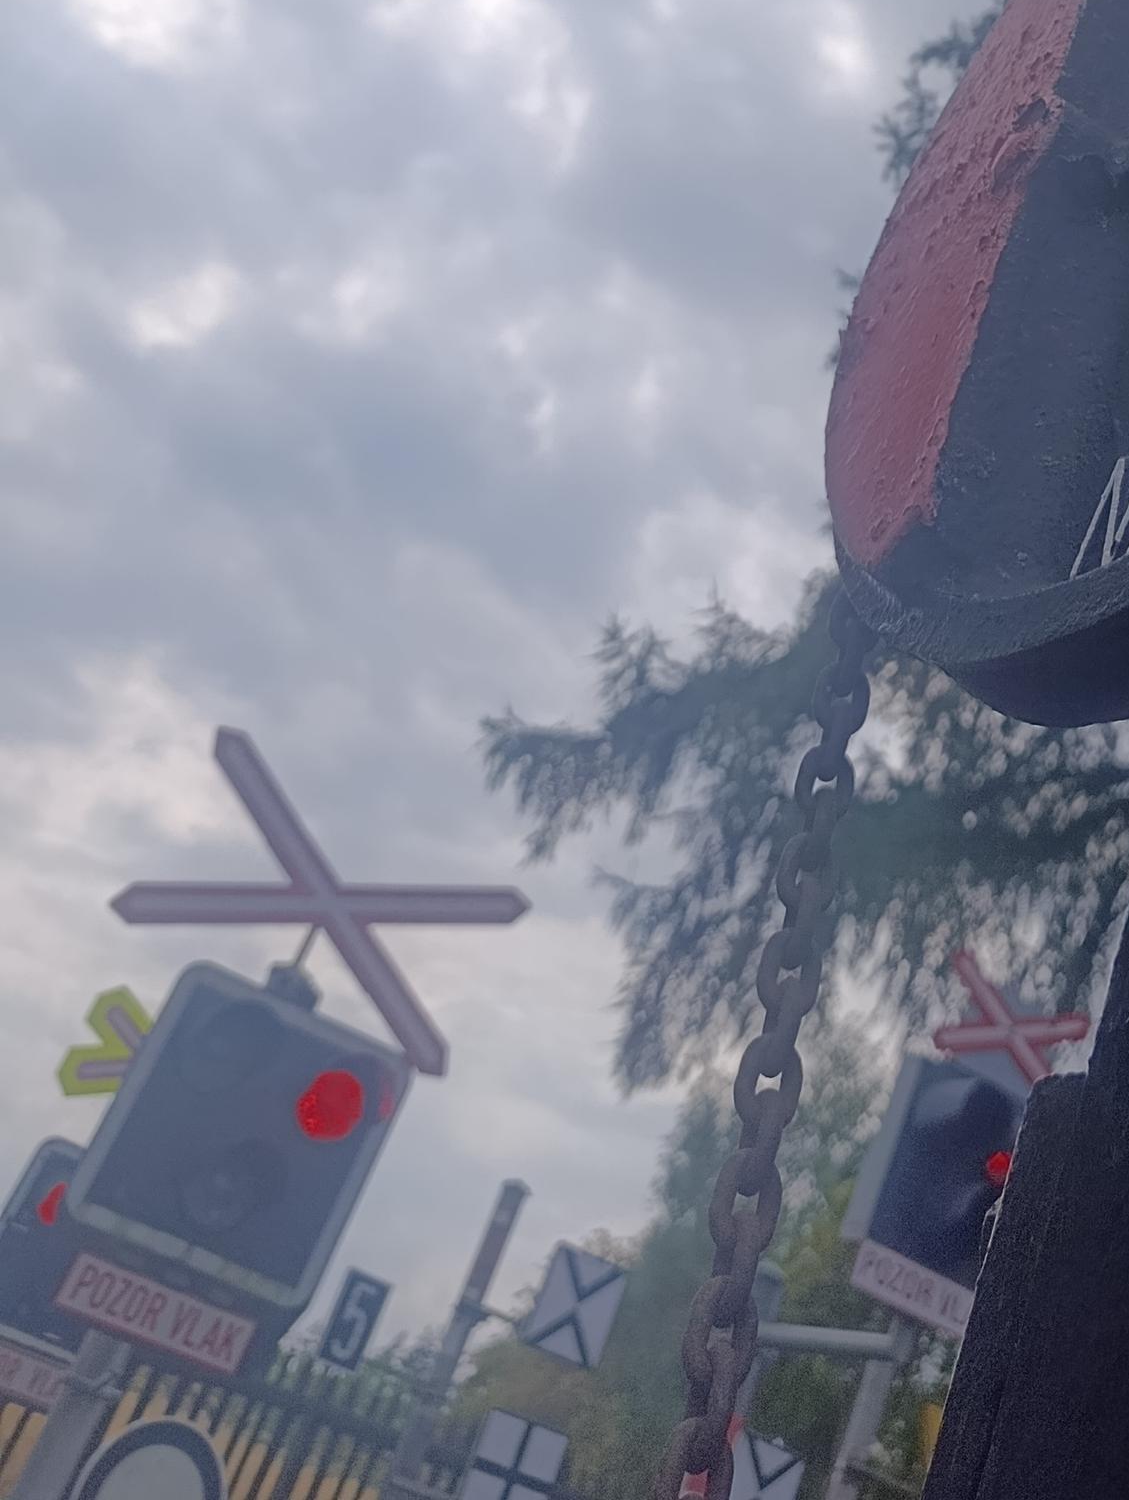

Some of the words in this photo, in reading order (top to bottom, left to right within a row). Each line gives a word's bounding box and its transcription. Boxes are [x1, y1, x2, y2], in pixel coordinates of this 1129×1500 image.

[69, 1263, 169, 1332] POZOR
[169, 1301, 245, 1363] VLAK
[329, 1280, 379, 1361] 5
